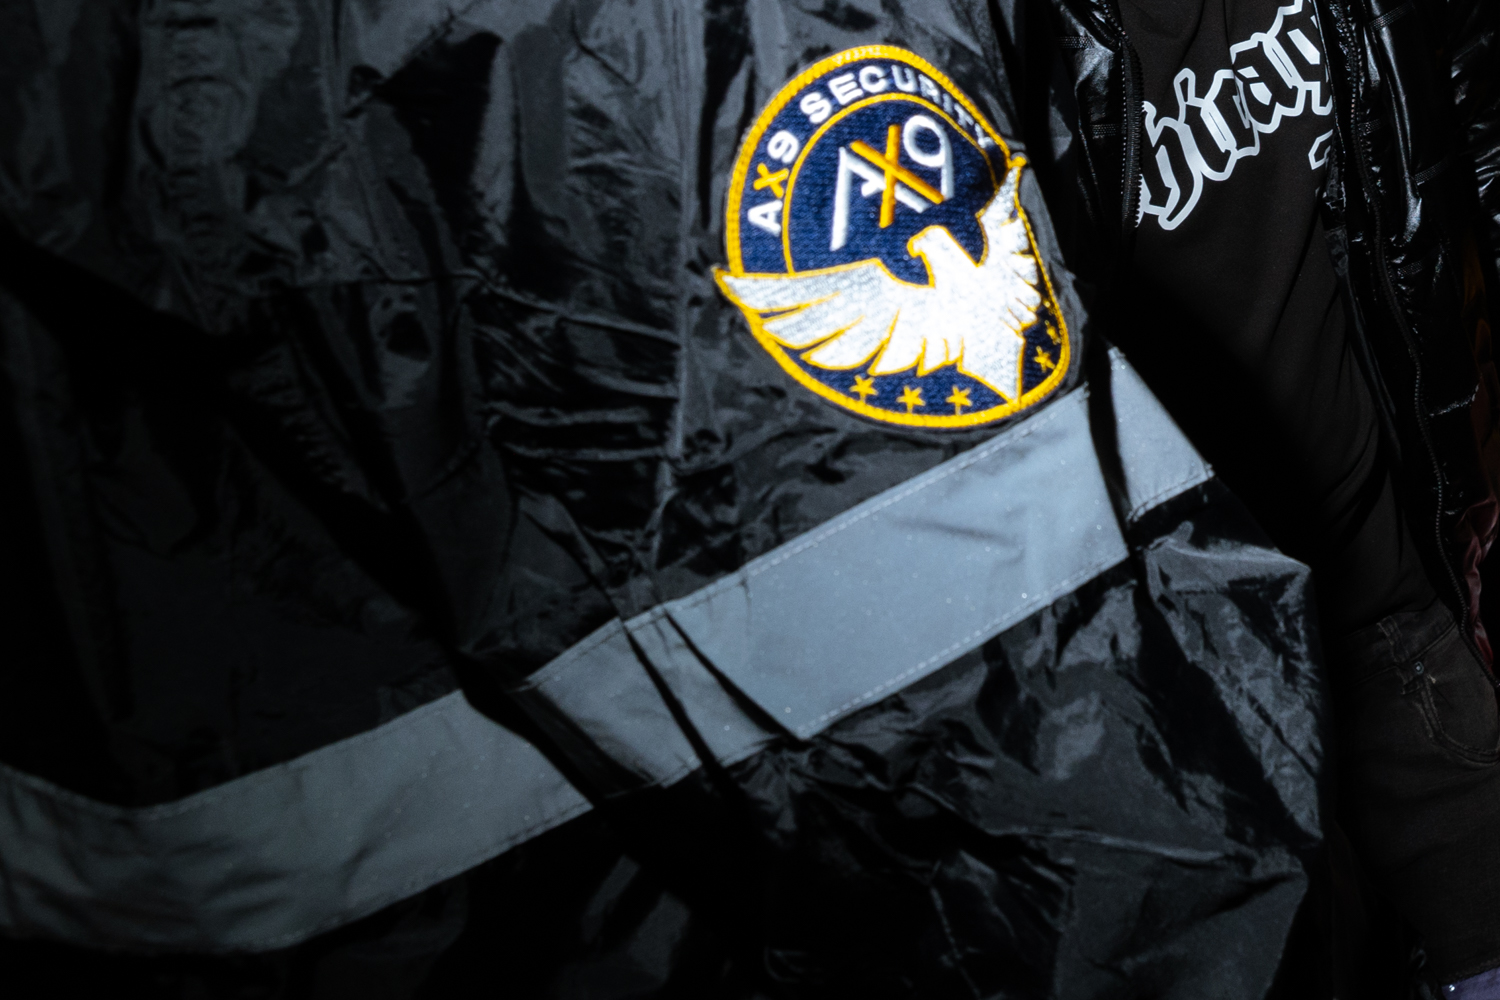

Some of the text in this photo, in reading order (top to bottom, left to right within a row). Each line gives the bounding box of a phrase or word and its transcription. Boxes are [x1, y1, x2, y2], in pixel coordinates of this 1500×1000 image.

[747, 65, 993, 237] AX9 SECURITY
[829, 115, 956, 252] AX9
